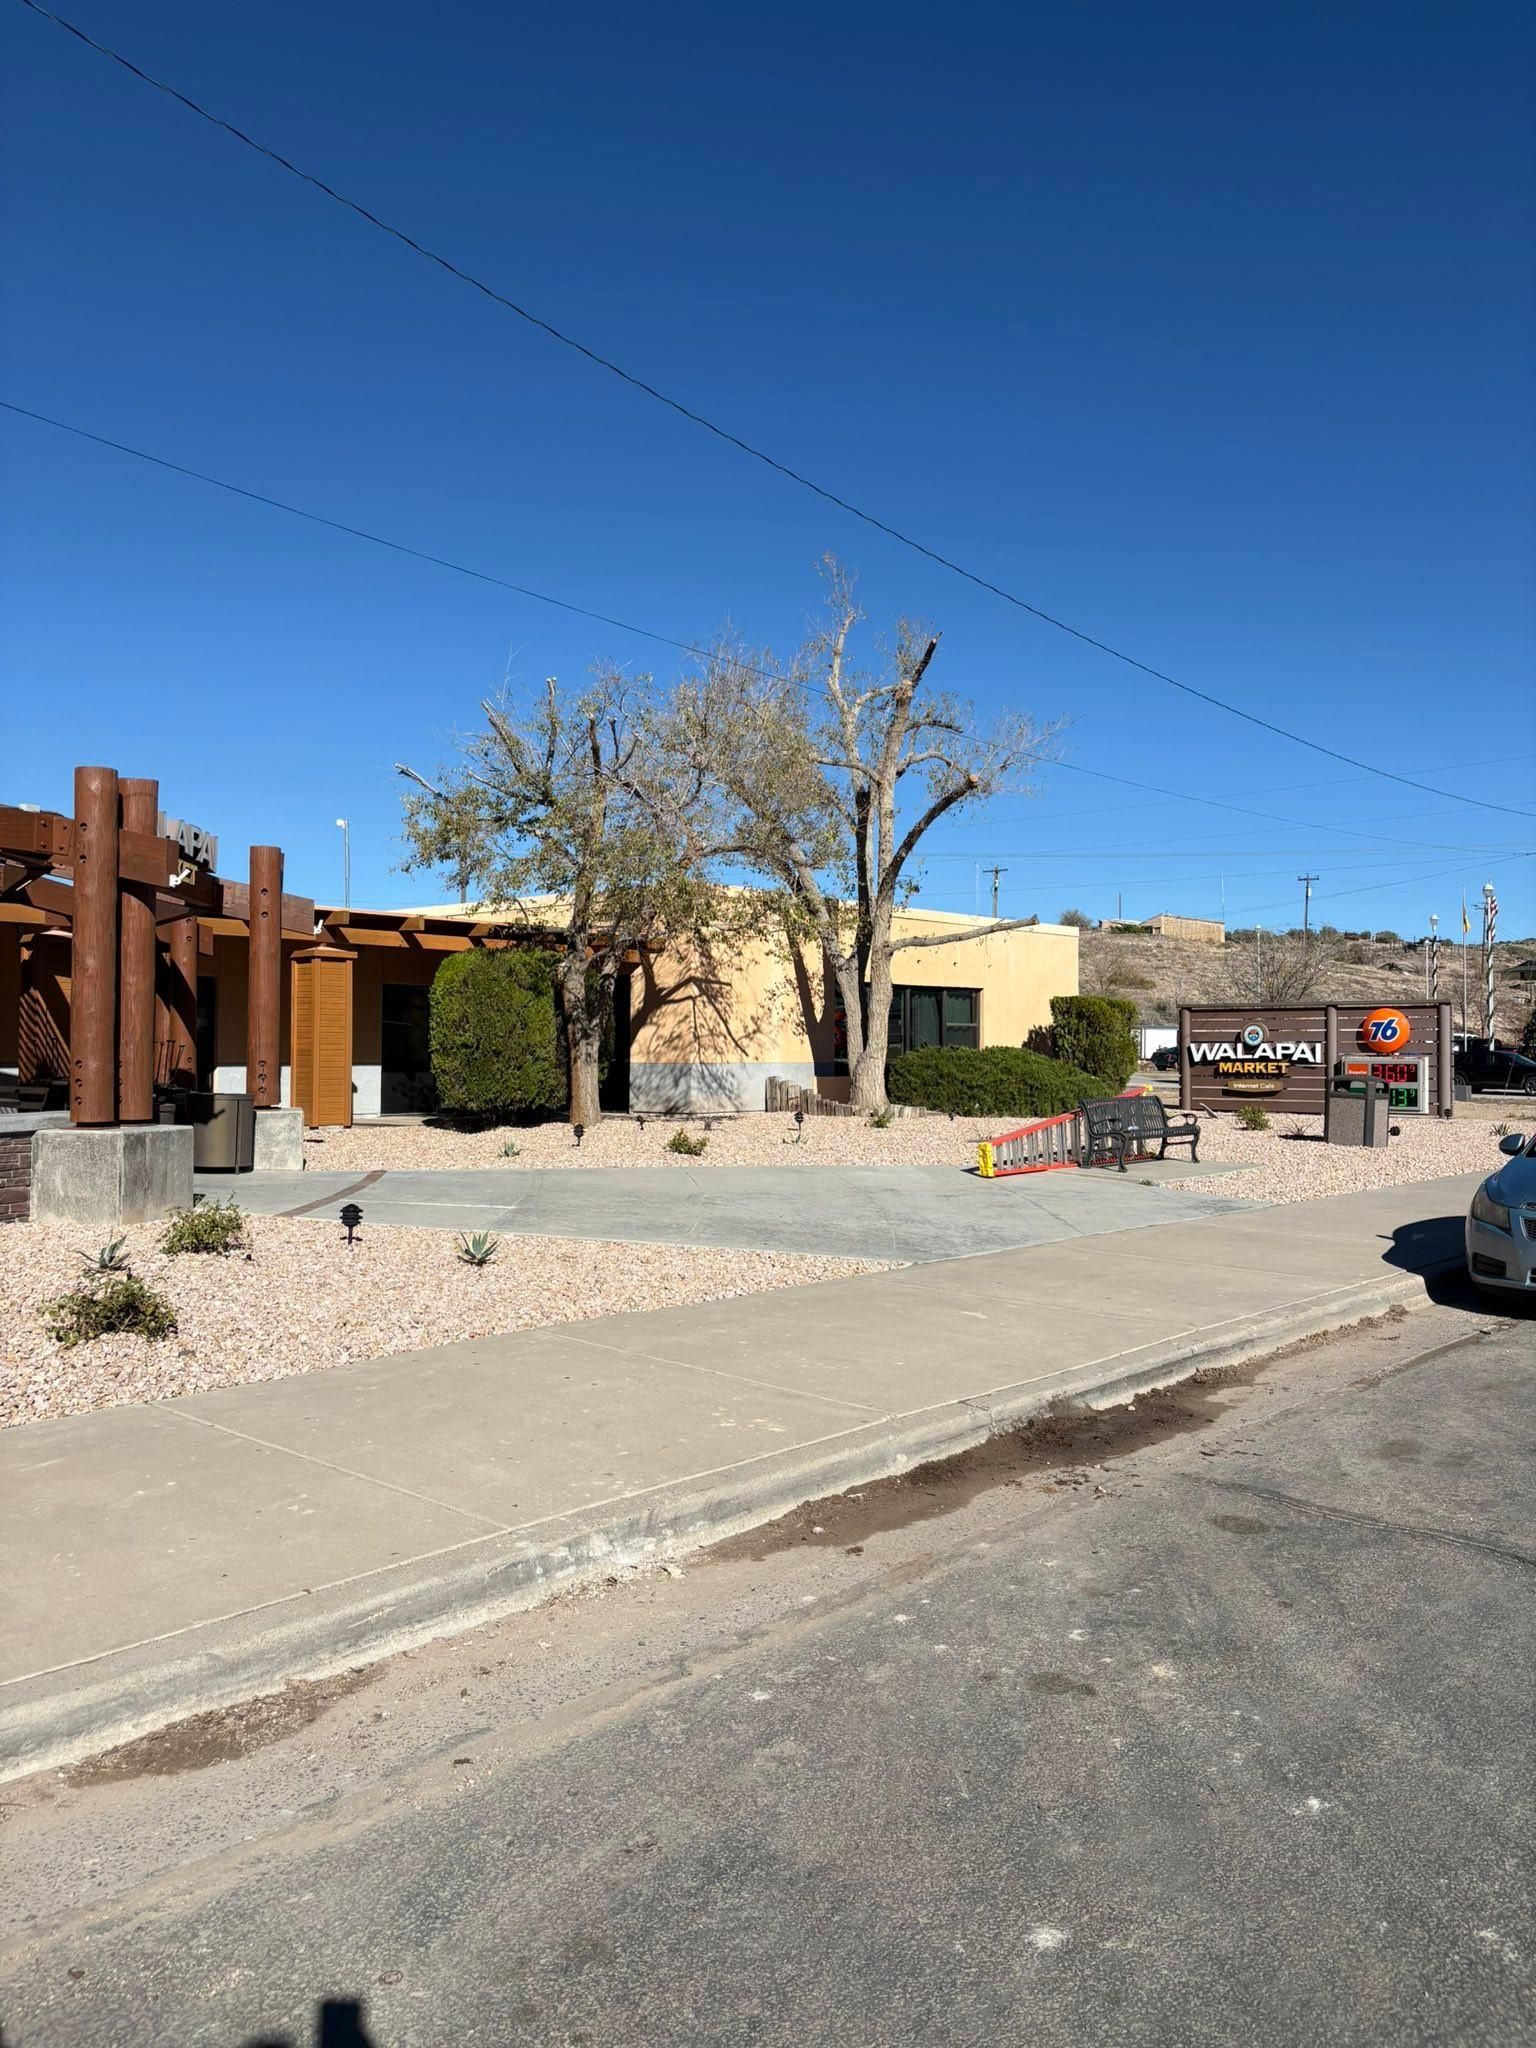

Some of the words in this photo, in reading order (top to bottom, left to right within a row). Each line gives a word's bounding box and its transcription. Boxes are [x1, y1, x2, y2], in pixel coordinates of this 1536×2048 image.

[1369, 1017, 1400, 1042] 76
[1190, 1042, 1322, 1064] WALAPAI
[1219, 1062, 1291, 1074] MARKET
